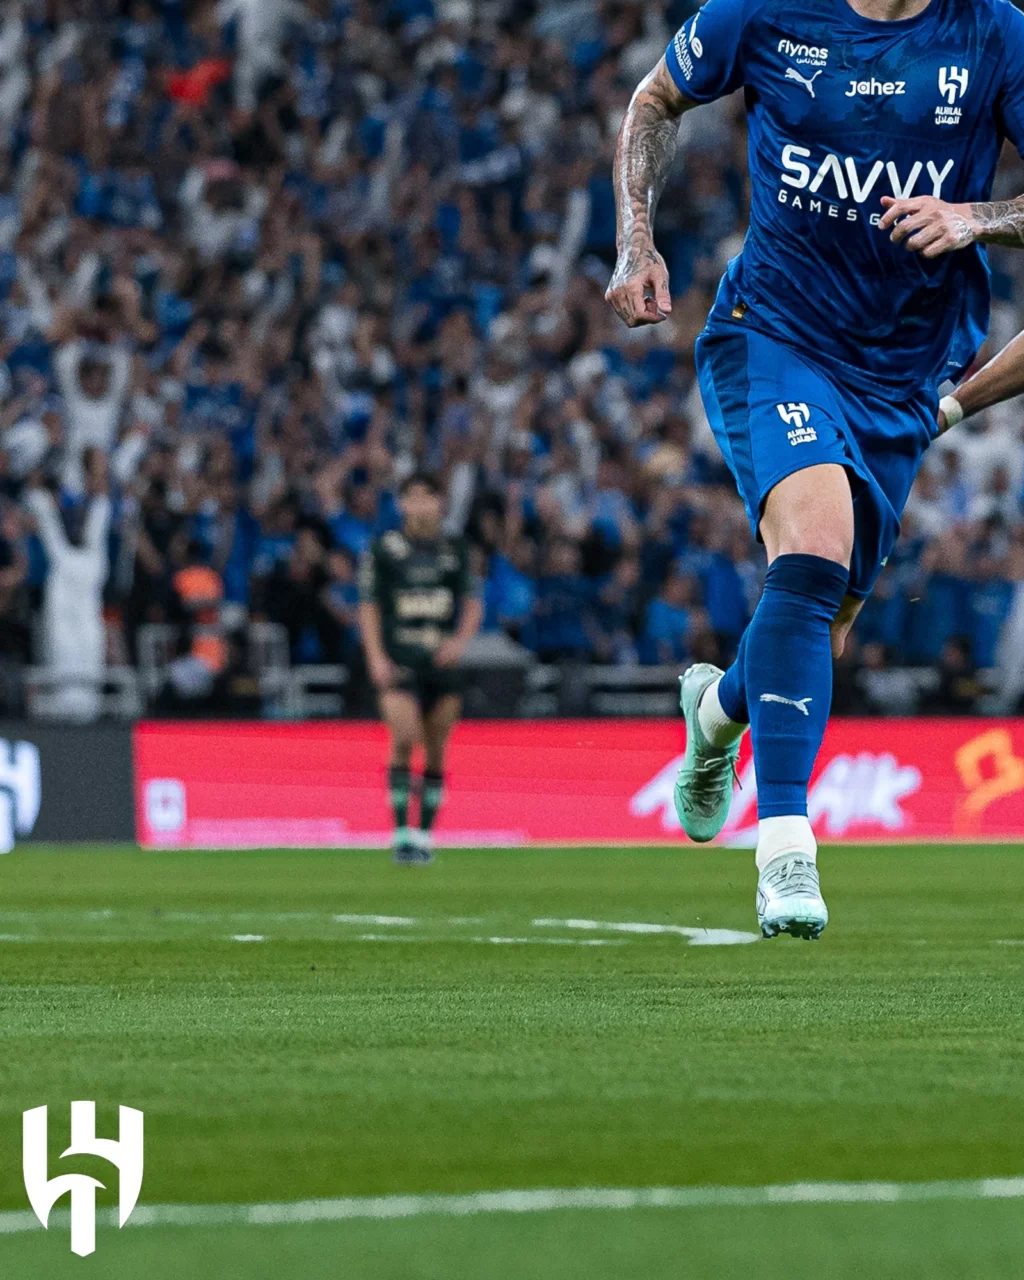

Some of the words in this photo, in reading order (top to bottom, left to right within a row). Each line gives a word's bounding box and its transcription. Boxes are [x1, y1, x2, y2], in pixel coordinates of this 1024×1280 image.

[777, 39, 829, 60] flynas
[781, 144, 955, 203] SAVVY
[777, 189, 857, 222] GAMES
